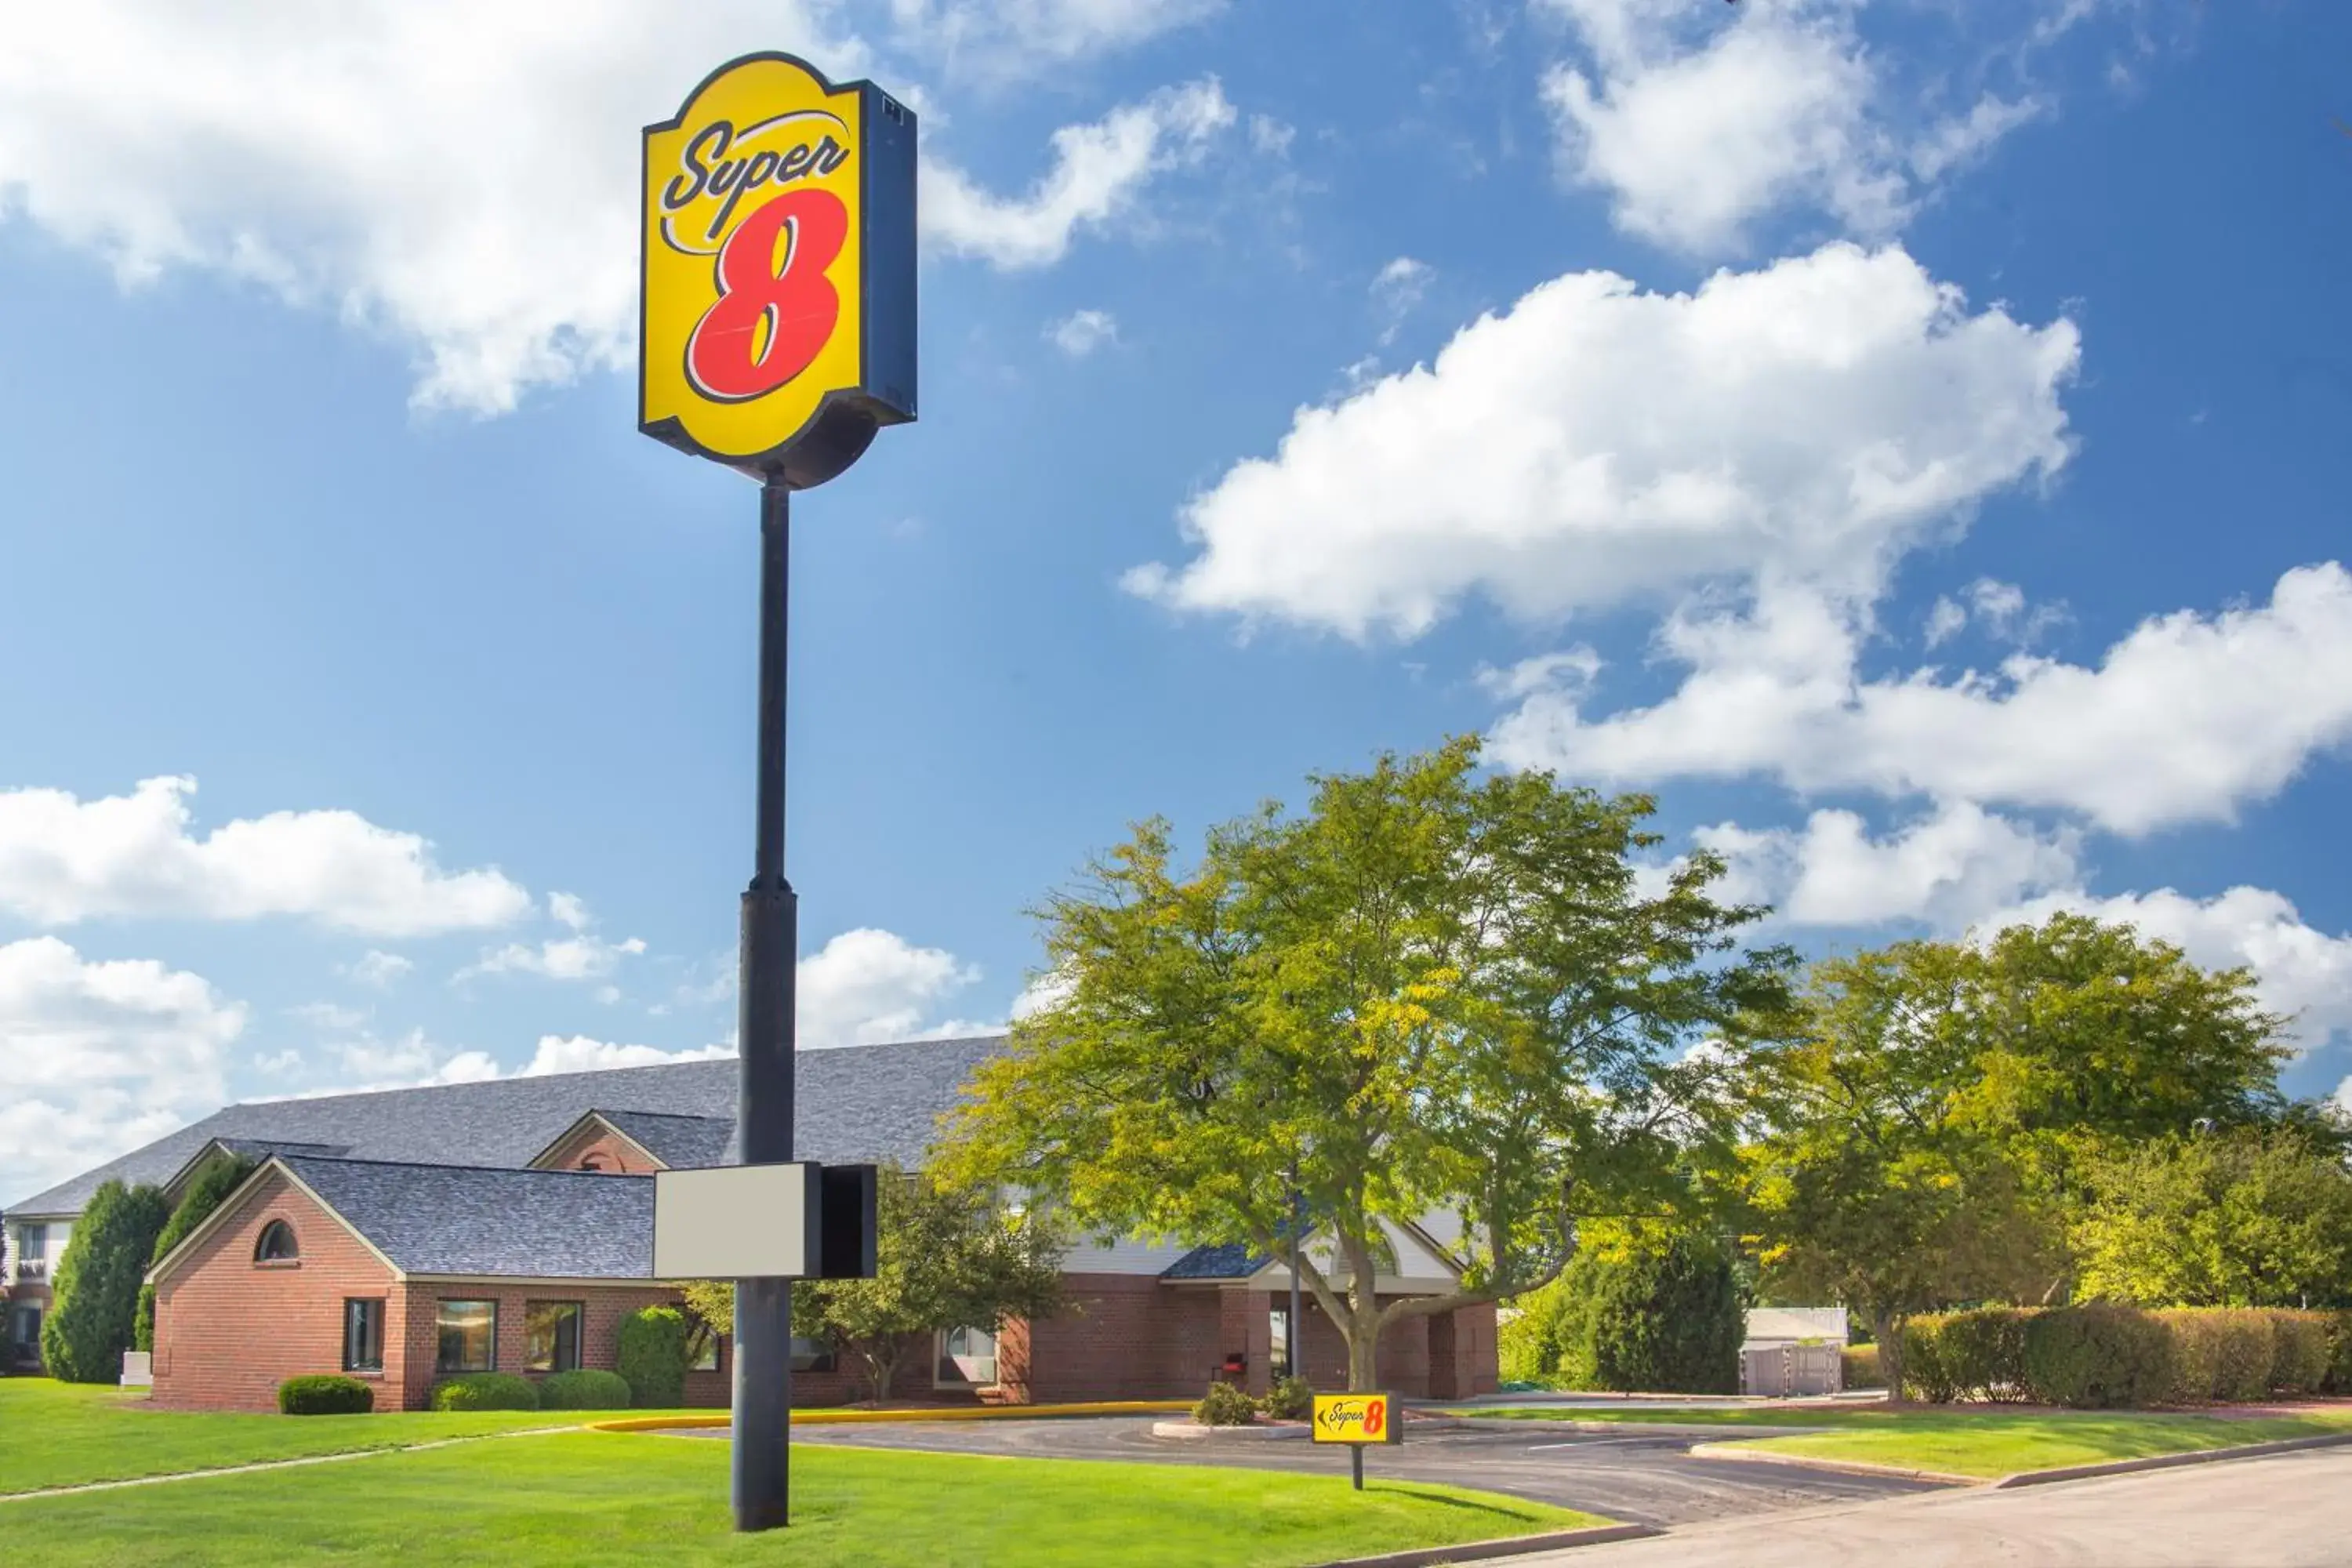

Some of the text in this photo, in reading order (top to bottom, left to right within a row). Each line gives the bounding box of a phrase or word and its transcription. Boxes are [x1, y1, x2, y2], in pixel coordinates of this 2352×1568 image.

[662, 120, 851, 241] Super
[684, 188, 848, 404] 8
[1330, 1400, 1384, 1434] Super 8
